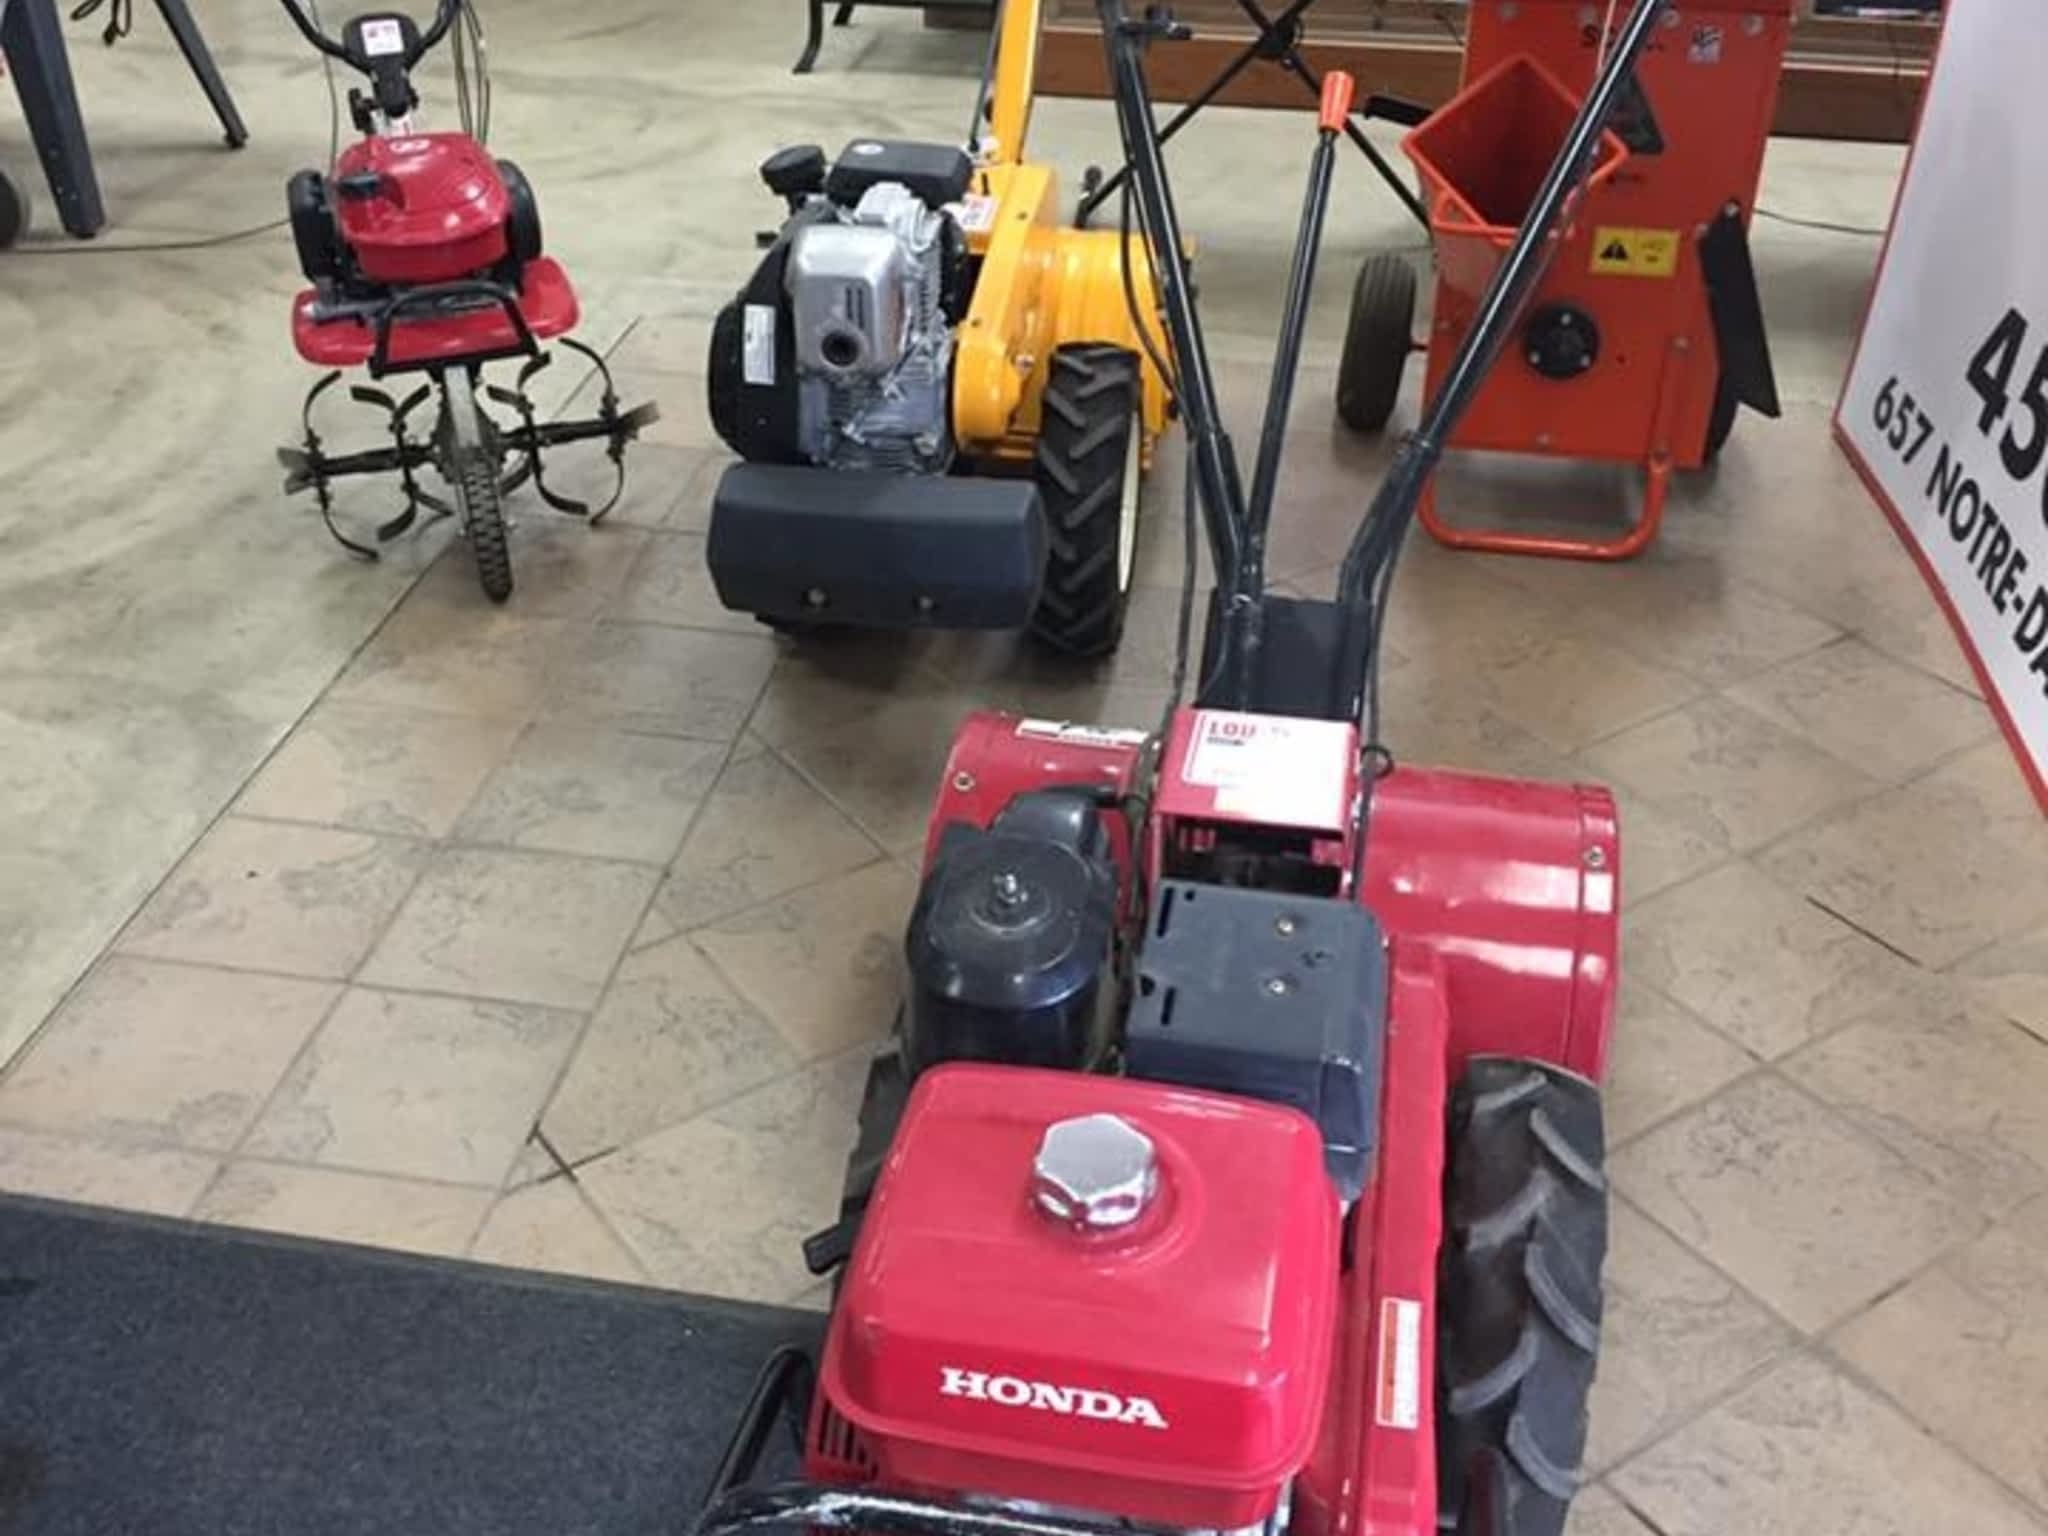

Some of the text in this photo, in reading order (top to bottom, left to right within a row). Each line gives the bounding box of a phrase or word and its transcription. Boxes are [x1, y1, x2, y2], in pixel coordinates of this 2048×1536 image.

[1873, 376, 1934, 464] 657
[1966, 308, 2048, 527] 45
[940, 1367, 1169, 1429] HONDA
